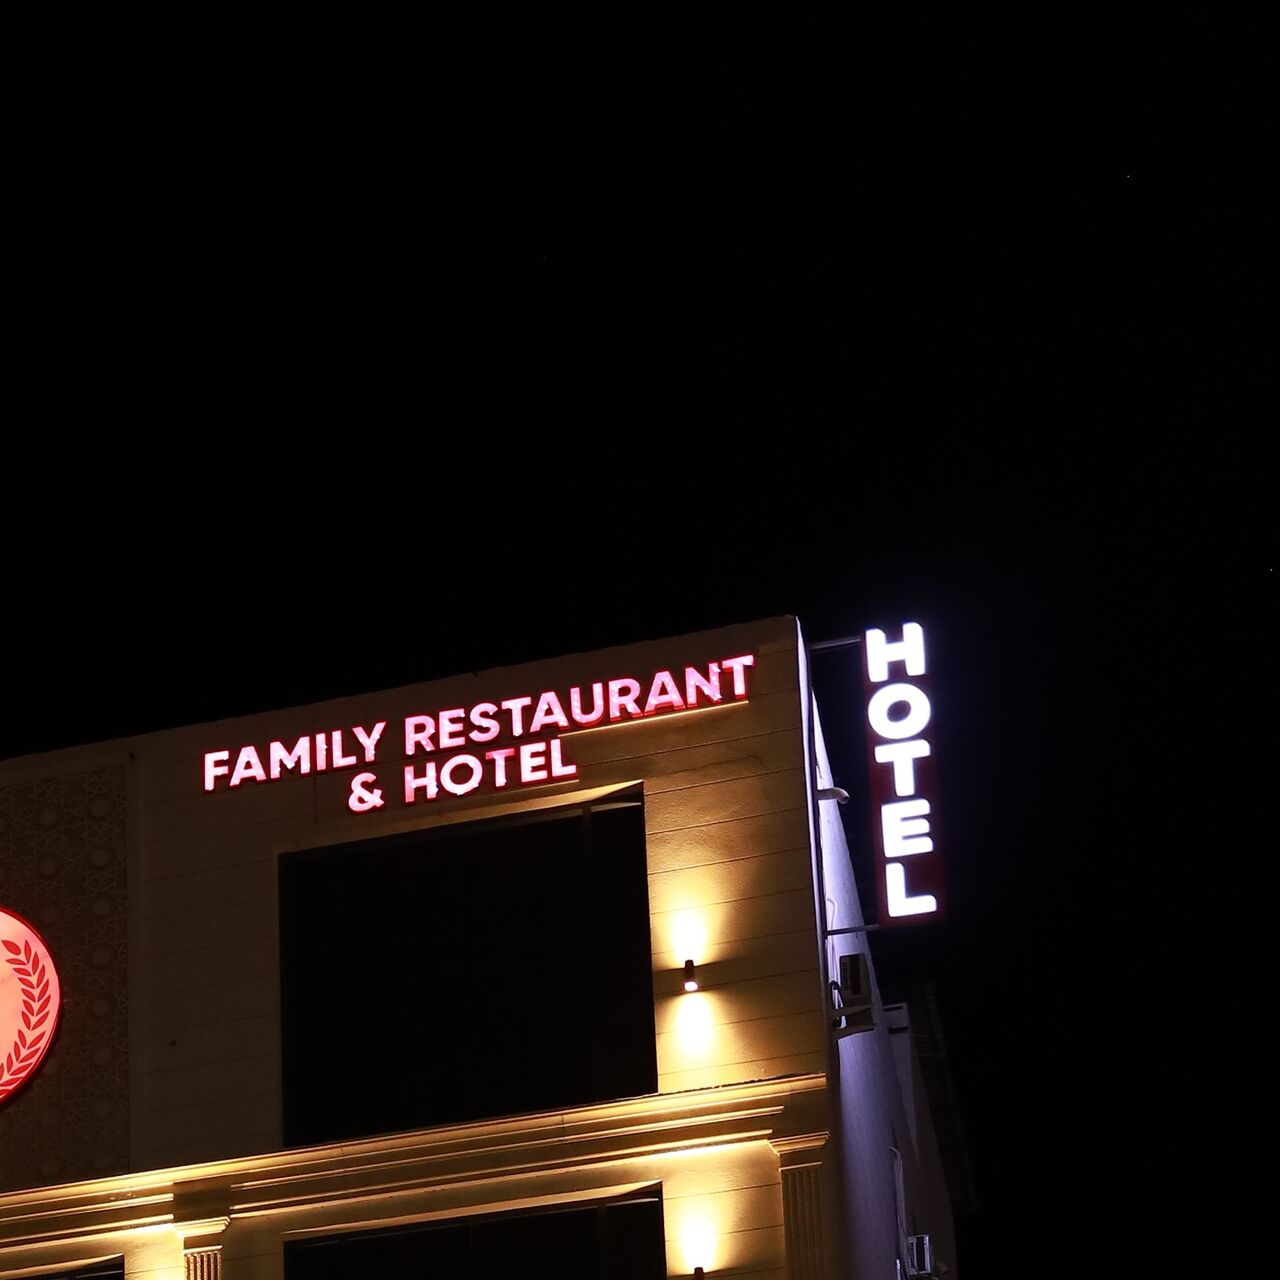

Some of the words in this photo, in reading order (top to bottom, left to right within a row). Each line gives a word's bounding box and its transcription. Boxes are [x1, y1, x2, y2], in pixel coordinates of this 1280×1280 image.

[202, 721, 387, 794] FAMILY
[403, 654, 756, 756] RESTAURANT
[347, 772, 384, 813] &
[403, 738, 577, 806] HOTEL
[865, 622, 937, 918] HOTEL
